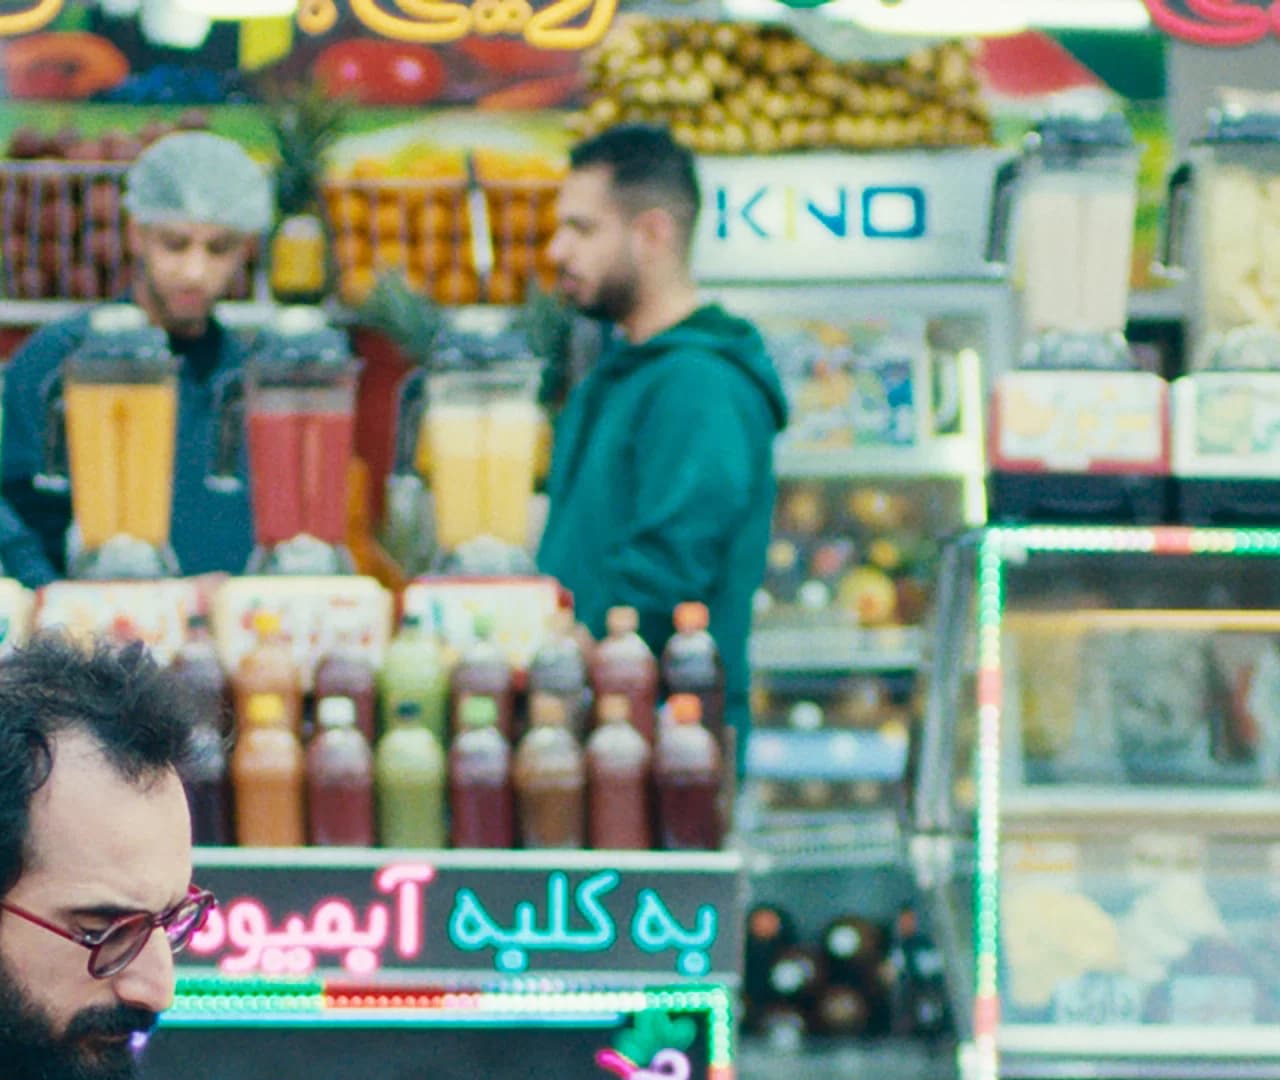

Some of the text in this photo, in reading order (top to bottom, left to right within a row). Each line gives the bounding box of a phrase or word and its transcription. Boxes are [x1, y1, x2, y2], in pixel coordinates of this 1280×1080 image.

[715, 184, 927, 240] KINO
[448, 868, 621, 974] کلبه
[632, 887, 718, 976] به
